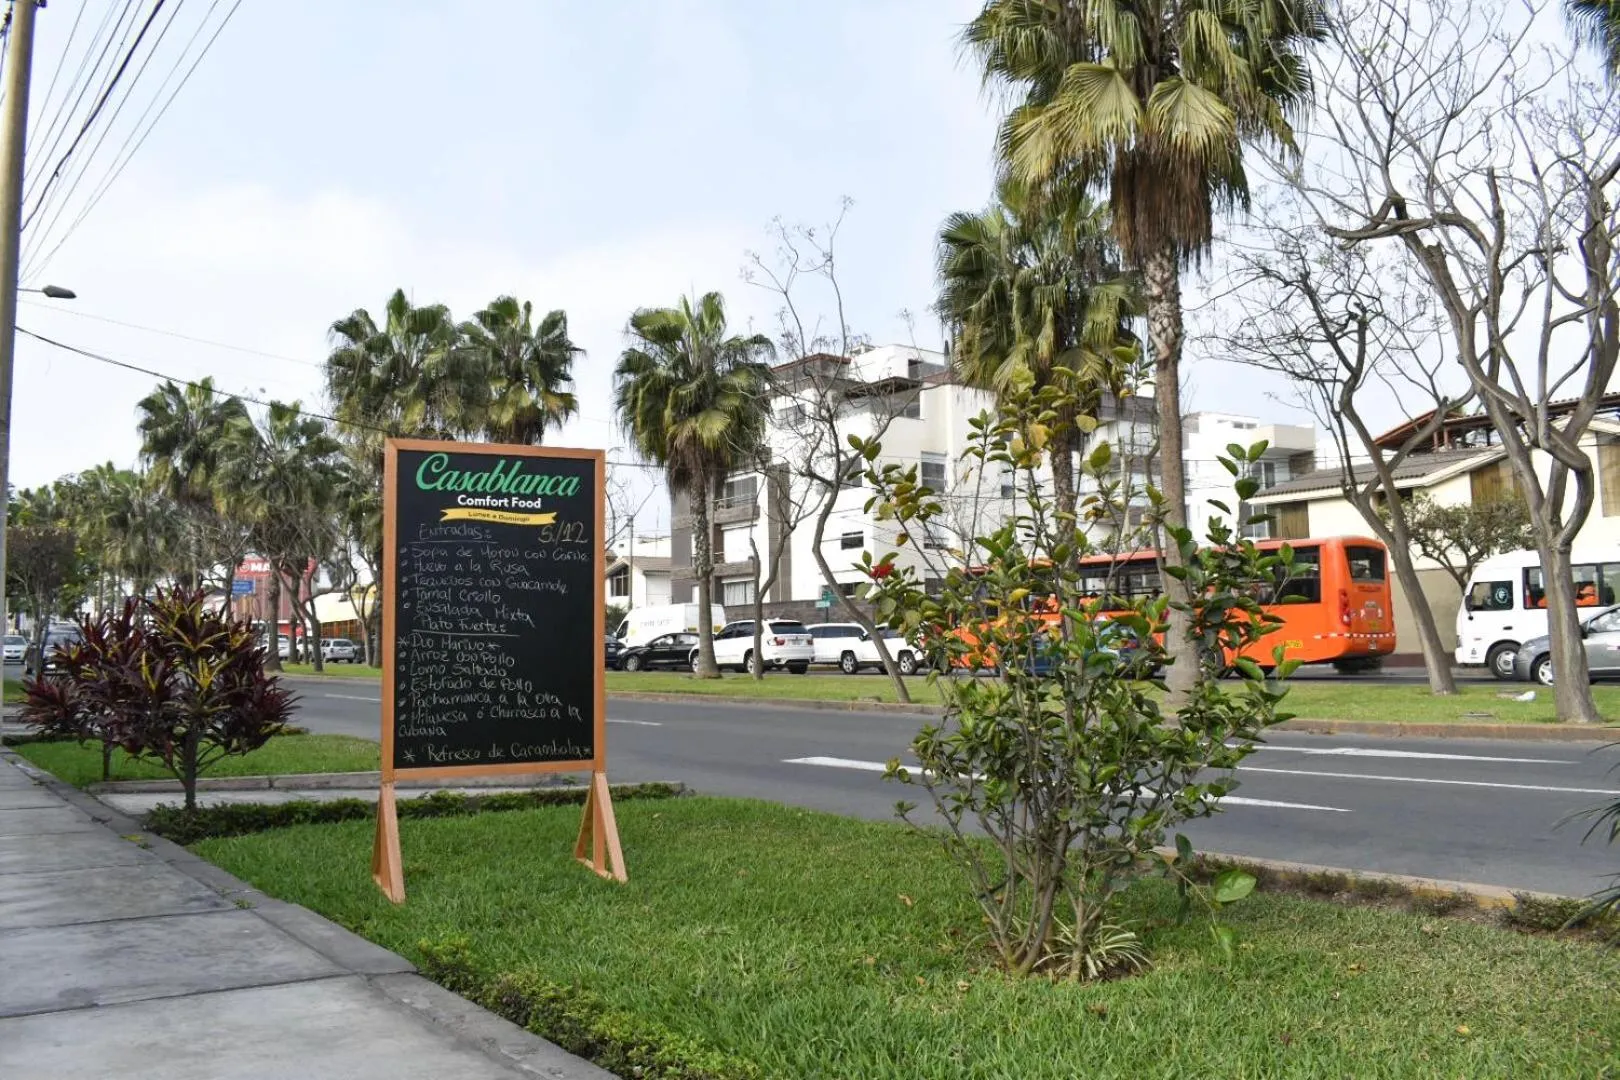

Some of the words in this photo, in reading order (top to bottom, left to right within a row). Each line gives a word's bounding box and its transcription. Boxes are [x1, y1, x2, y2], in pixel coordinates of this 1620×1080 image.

[416, 452, 580, 496] Casablanca
[457, 494, 508, 507] Comfort
[511, 497, 541, 509] Food
[470, 559, 481, 573] la
[411, 648, 449, 662] Arroz
[410, 660, 446, 676] Lomo
